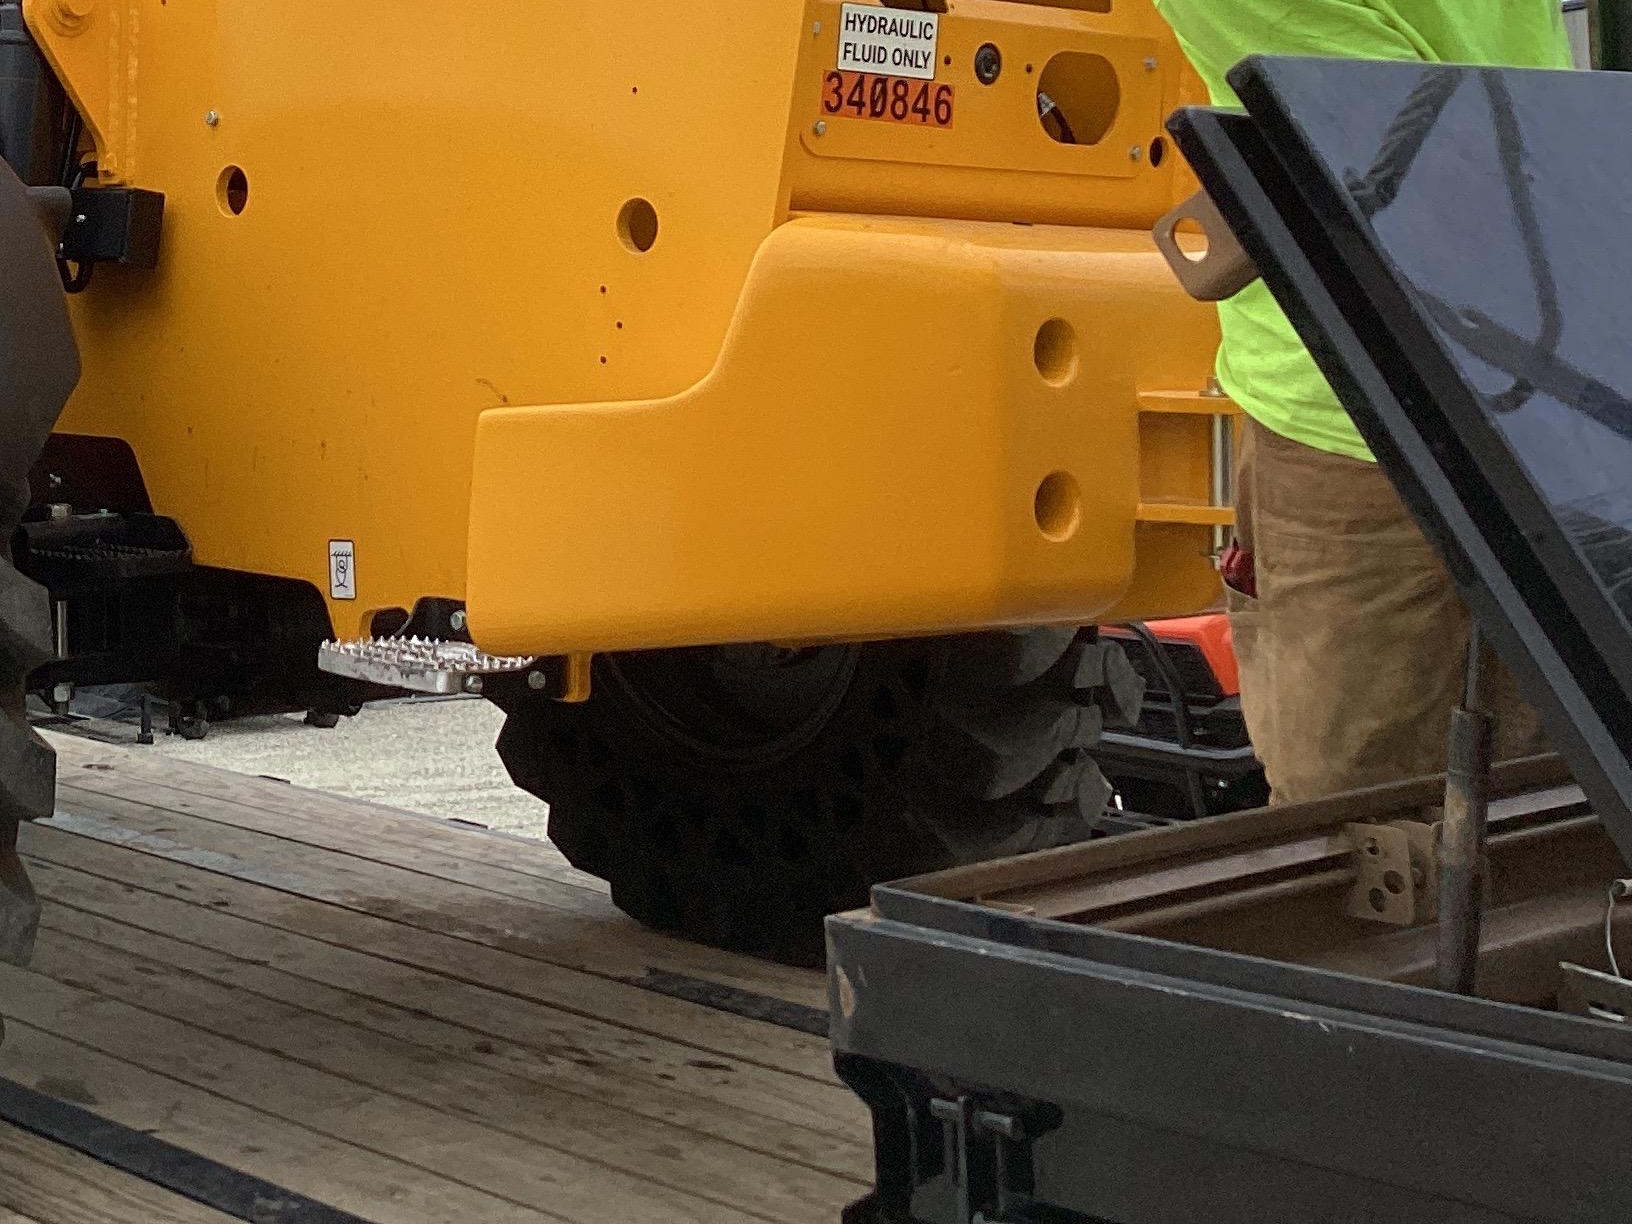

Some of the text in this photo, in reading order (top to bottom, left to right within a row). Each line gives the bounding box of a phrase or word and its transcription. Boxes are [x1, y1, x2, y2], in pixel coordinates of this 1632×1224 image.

[844, 12, 934, 41] HYDRAULIC
[843, 42, 932, 70] FLUID ONLY
[823, 71, 952, 125] 340846
